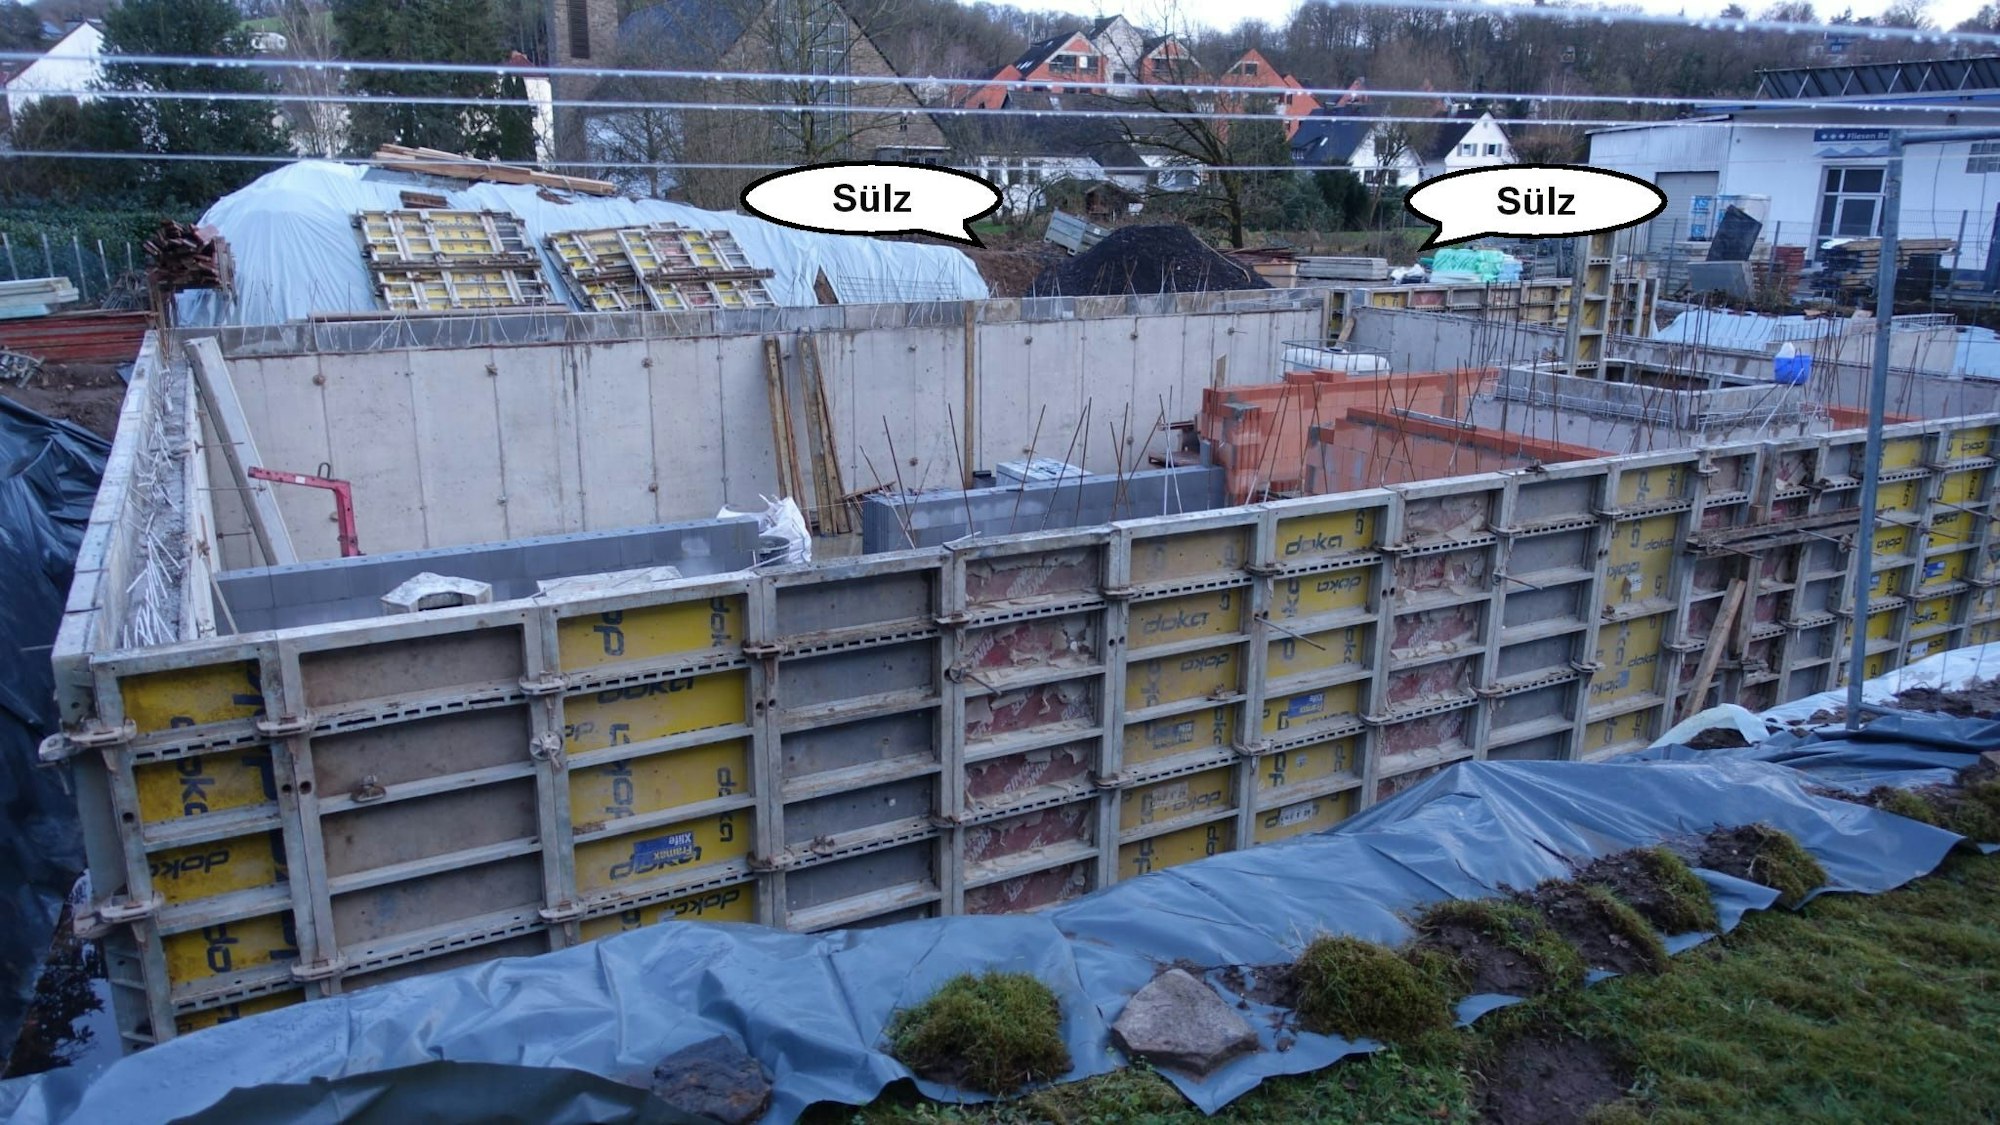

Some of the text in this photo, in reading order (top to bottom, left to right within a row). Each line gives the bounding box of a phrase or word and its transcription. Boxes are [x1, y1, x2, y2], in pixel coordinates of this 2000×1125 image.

[1285, 532, 1343, 555] doka
[1316, 577, 1363, 594] doka
[1143, 609, 1209, 635] doka
[1180, 653, 1229, 672] doka
[669, 832, 692, 845] Xlife
[654, 846, 692, 859] Framax
